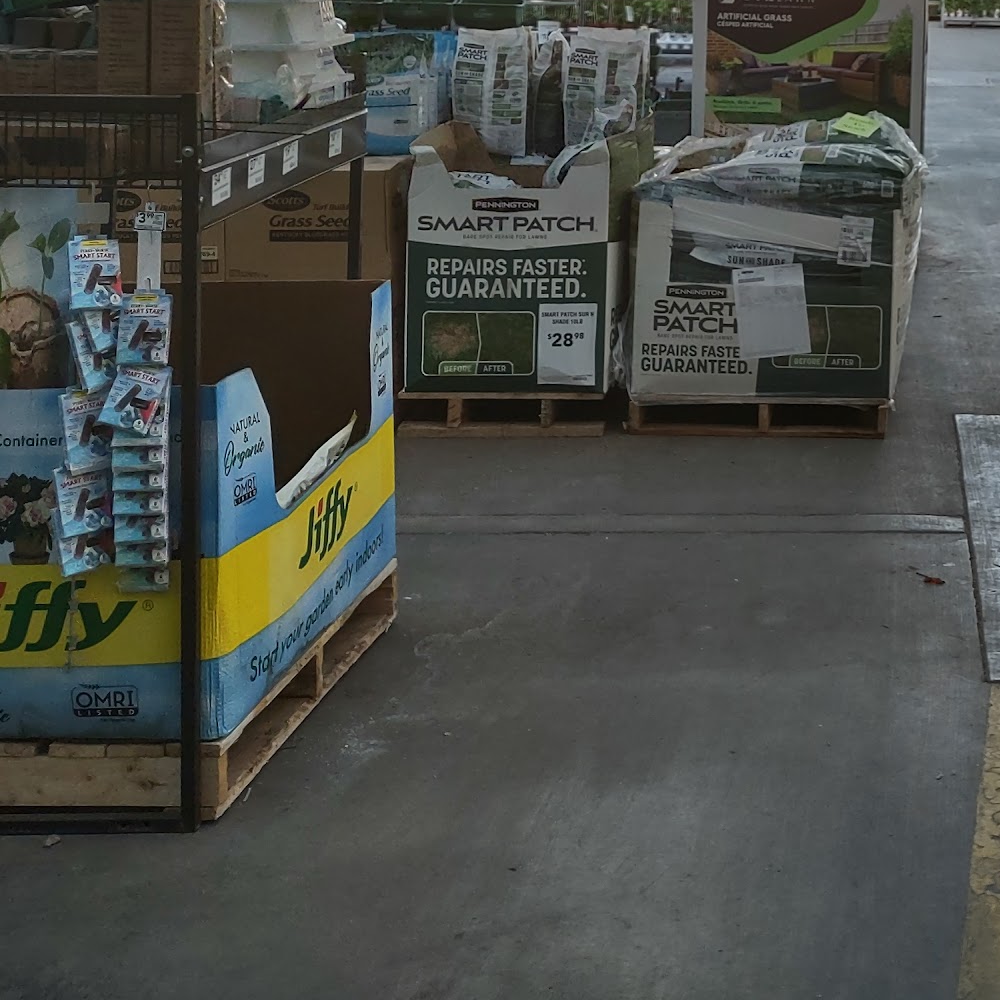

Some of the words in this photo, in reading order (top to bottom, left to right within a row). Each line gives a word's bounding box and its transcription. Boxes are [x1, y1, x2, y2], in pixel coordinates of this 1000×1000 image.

[717, 12, 762, 21] ARTIFICIAL
[763, 13, 793, 22] GRASS
[741, 21, 774, 29] ARTIFICIAL
[458, 52, 487, 61] PATCH
[459, 46, 488, 56] SMART
[571, 52, 599, 61] SMART
[569, 58, 599, 67] PATCH
[386, 87, 411, 96] Seed
[267, 196, 305, 205] Scotts
[475, 200, 536, 209] PENNINGTON
[269, 214, 312, 227] Grass
[417, 215, 509, 232] SMART
[513, 216, 595, 232] PATCH
[73, 252, 95, 261] SMART
[96, 252, 116, 260] START
[726, 255, 744, 265] SUN
[426, 258, 507, 275] REPAIRS
[513, 258, 587, 275] FASTER.
[425, 277, 587, 298] GUARANTEED.
[668, 287, 724, 296] PENNINGTON
[123, 308, 144, 316] SMART
[654, 299, 736, 317] SMART
[653, 315, 738, 334] PATCH
[641, 343, 697, 357] REPAIRS
[701, 345, 741, 358] FASTE
[641, 357, 753, 374] GUARANTEED.
[793, 357, 821, 366] BEFORE
[831, 358, 854, 366] AFTER
[443, 365, 472, 373] BEFORE
[142, 372, 161, 385] START
[66, 403, 88, 414] SMART
[88, 400, 105, 409] STAR
[229, 411, 261, 435] NATURAL
[0, 433, 63, 447] ontainer
[243, 431, 249, 443] &
[223, 437, 265, 476] Organic
[233, 476, 256, 498] OMRI
[298, 478, 353, 570] Jiffy
[249, 640, 280, 682] Start
[279, 621, 304, 663] your
[304, 588, 334, 637] garden
[334, 559, 354, 595] early
[354, 524, 384, 572] indoors!
[0, 580, 138, 652] ffy
[76, 690, 134, 708] OMRI
